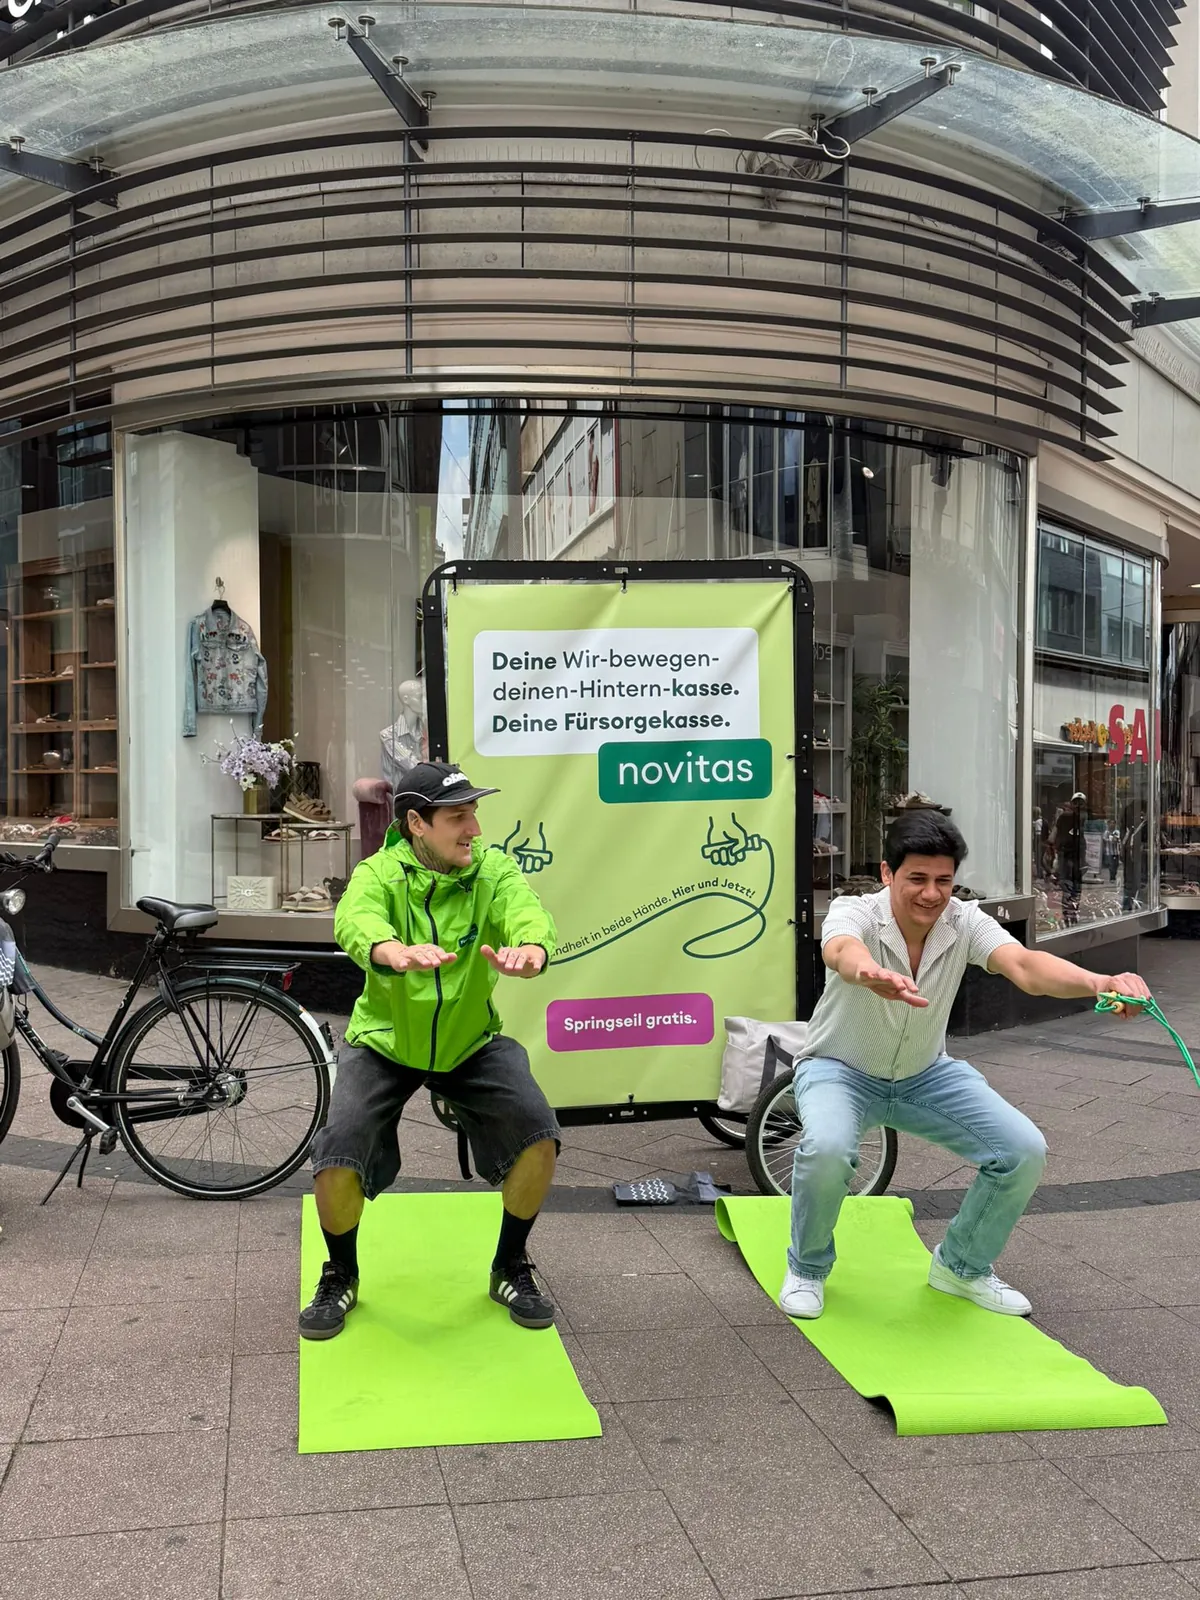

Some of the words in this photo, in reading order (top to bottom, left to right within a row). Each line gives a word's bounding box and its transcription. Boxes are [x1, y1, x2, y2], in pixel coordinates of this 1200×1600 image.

[492, 651, 557, 671] Deine
[562, 648, 719, 672] Wir-bewegen-
[492, 678, 740, 701] deinen-Hintern-kasse.
[492, 713, 558, 733] Deine
[564, 709, 731, 734] Fürsorgekasse.
[1108, 704, 1161, 767] SA
[619, 751, 753, 785] novitas
[552, 936, 590, 957] ndheit
[590, 932, 602, 942] in
[601, 916, 633, 936] beide
[632, 897, 672, 919] Hände.
[672, 884, 696, 899] Hier
[698, 877, 719, 890] und
[721, 879, 756, 899] Jetzt!
[564, 1012, 642, 1034] Springseil
[645, 1010, 698, 1030] gratis.
